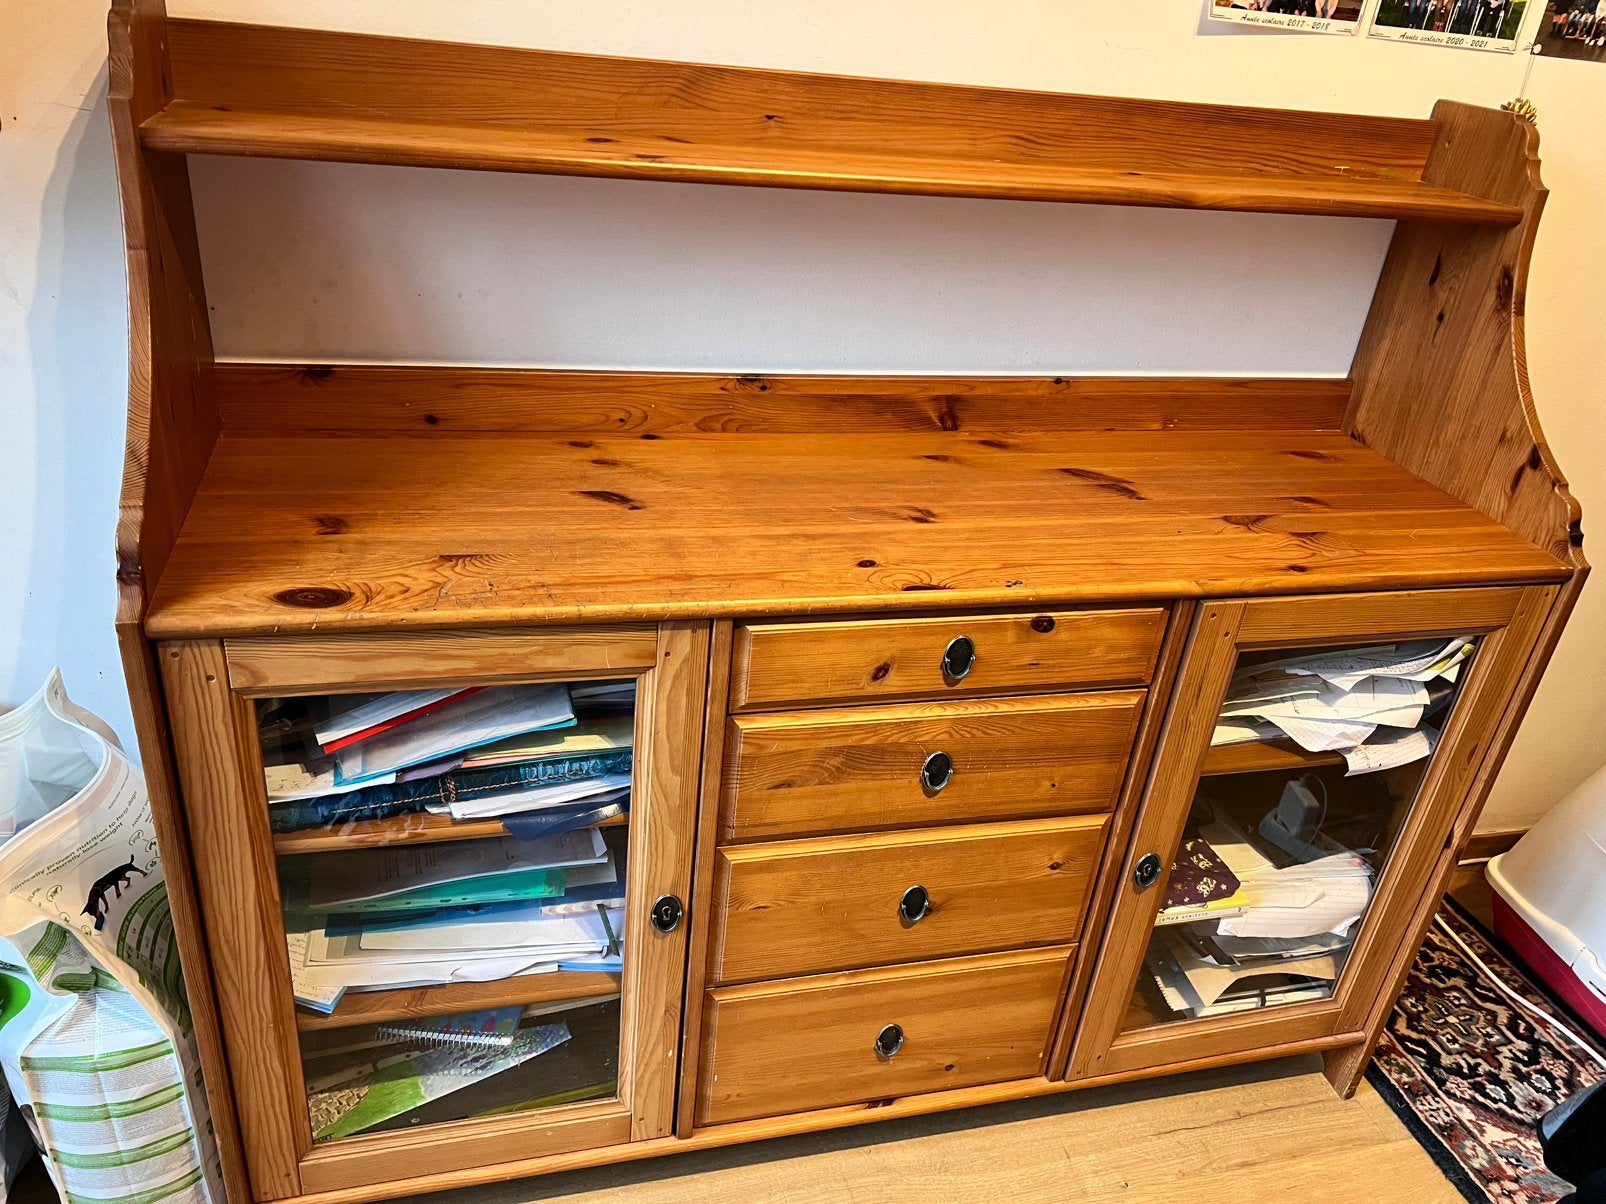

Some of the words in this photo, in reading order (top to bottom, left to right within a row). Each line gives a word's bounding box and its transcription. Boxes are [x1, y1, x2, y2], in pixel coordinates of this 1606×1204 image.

[1240, 14, 1260, 23] Année
[1261, 18, 1286, 26] scolaire
[1287, 18, 1306, 28] 2017
[1311, 21, 1331, 31] 2018
[1399, 32, 1419, 41] Année
[1420, 35, 1444, 43] scolaire
[1445, 36, 1465, 45] 2020
[1470, 39, 1489, 48] 2021
[46, 850, 76, 872] proven
[76, 828, 108, 852] nutrition
[108, 821, 116, 829] to
[116, 806, 129, 823] help
[128, 790, 137, 807] dogs
[45, 853, 81, 876] naturally
[82, 842, 99, 854] lose
[99, 822, 123, 843] weight
